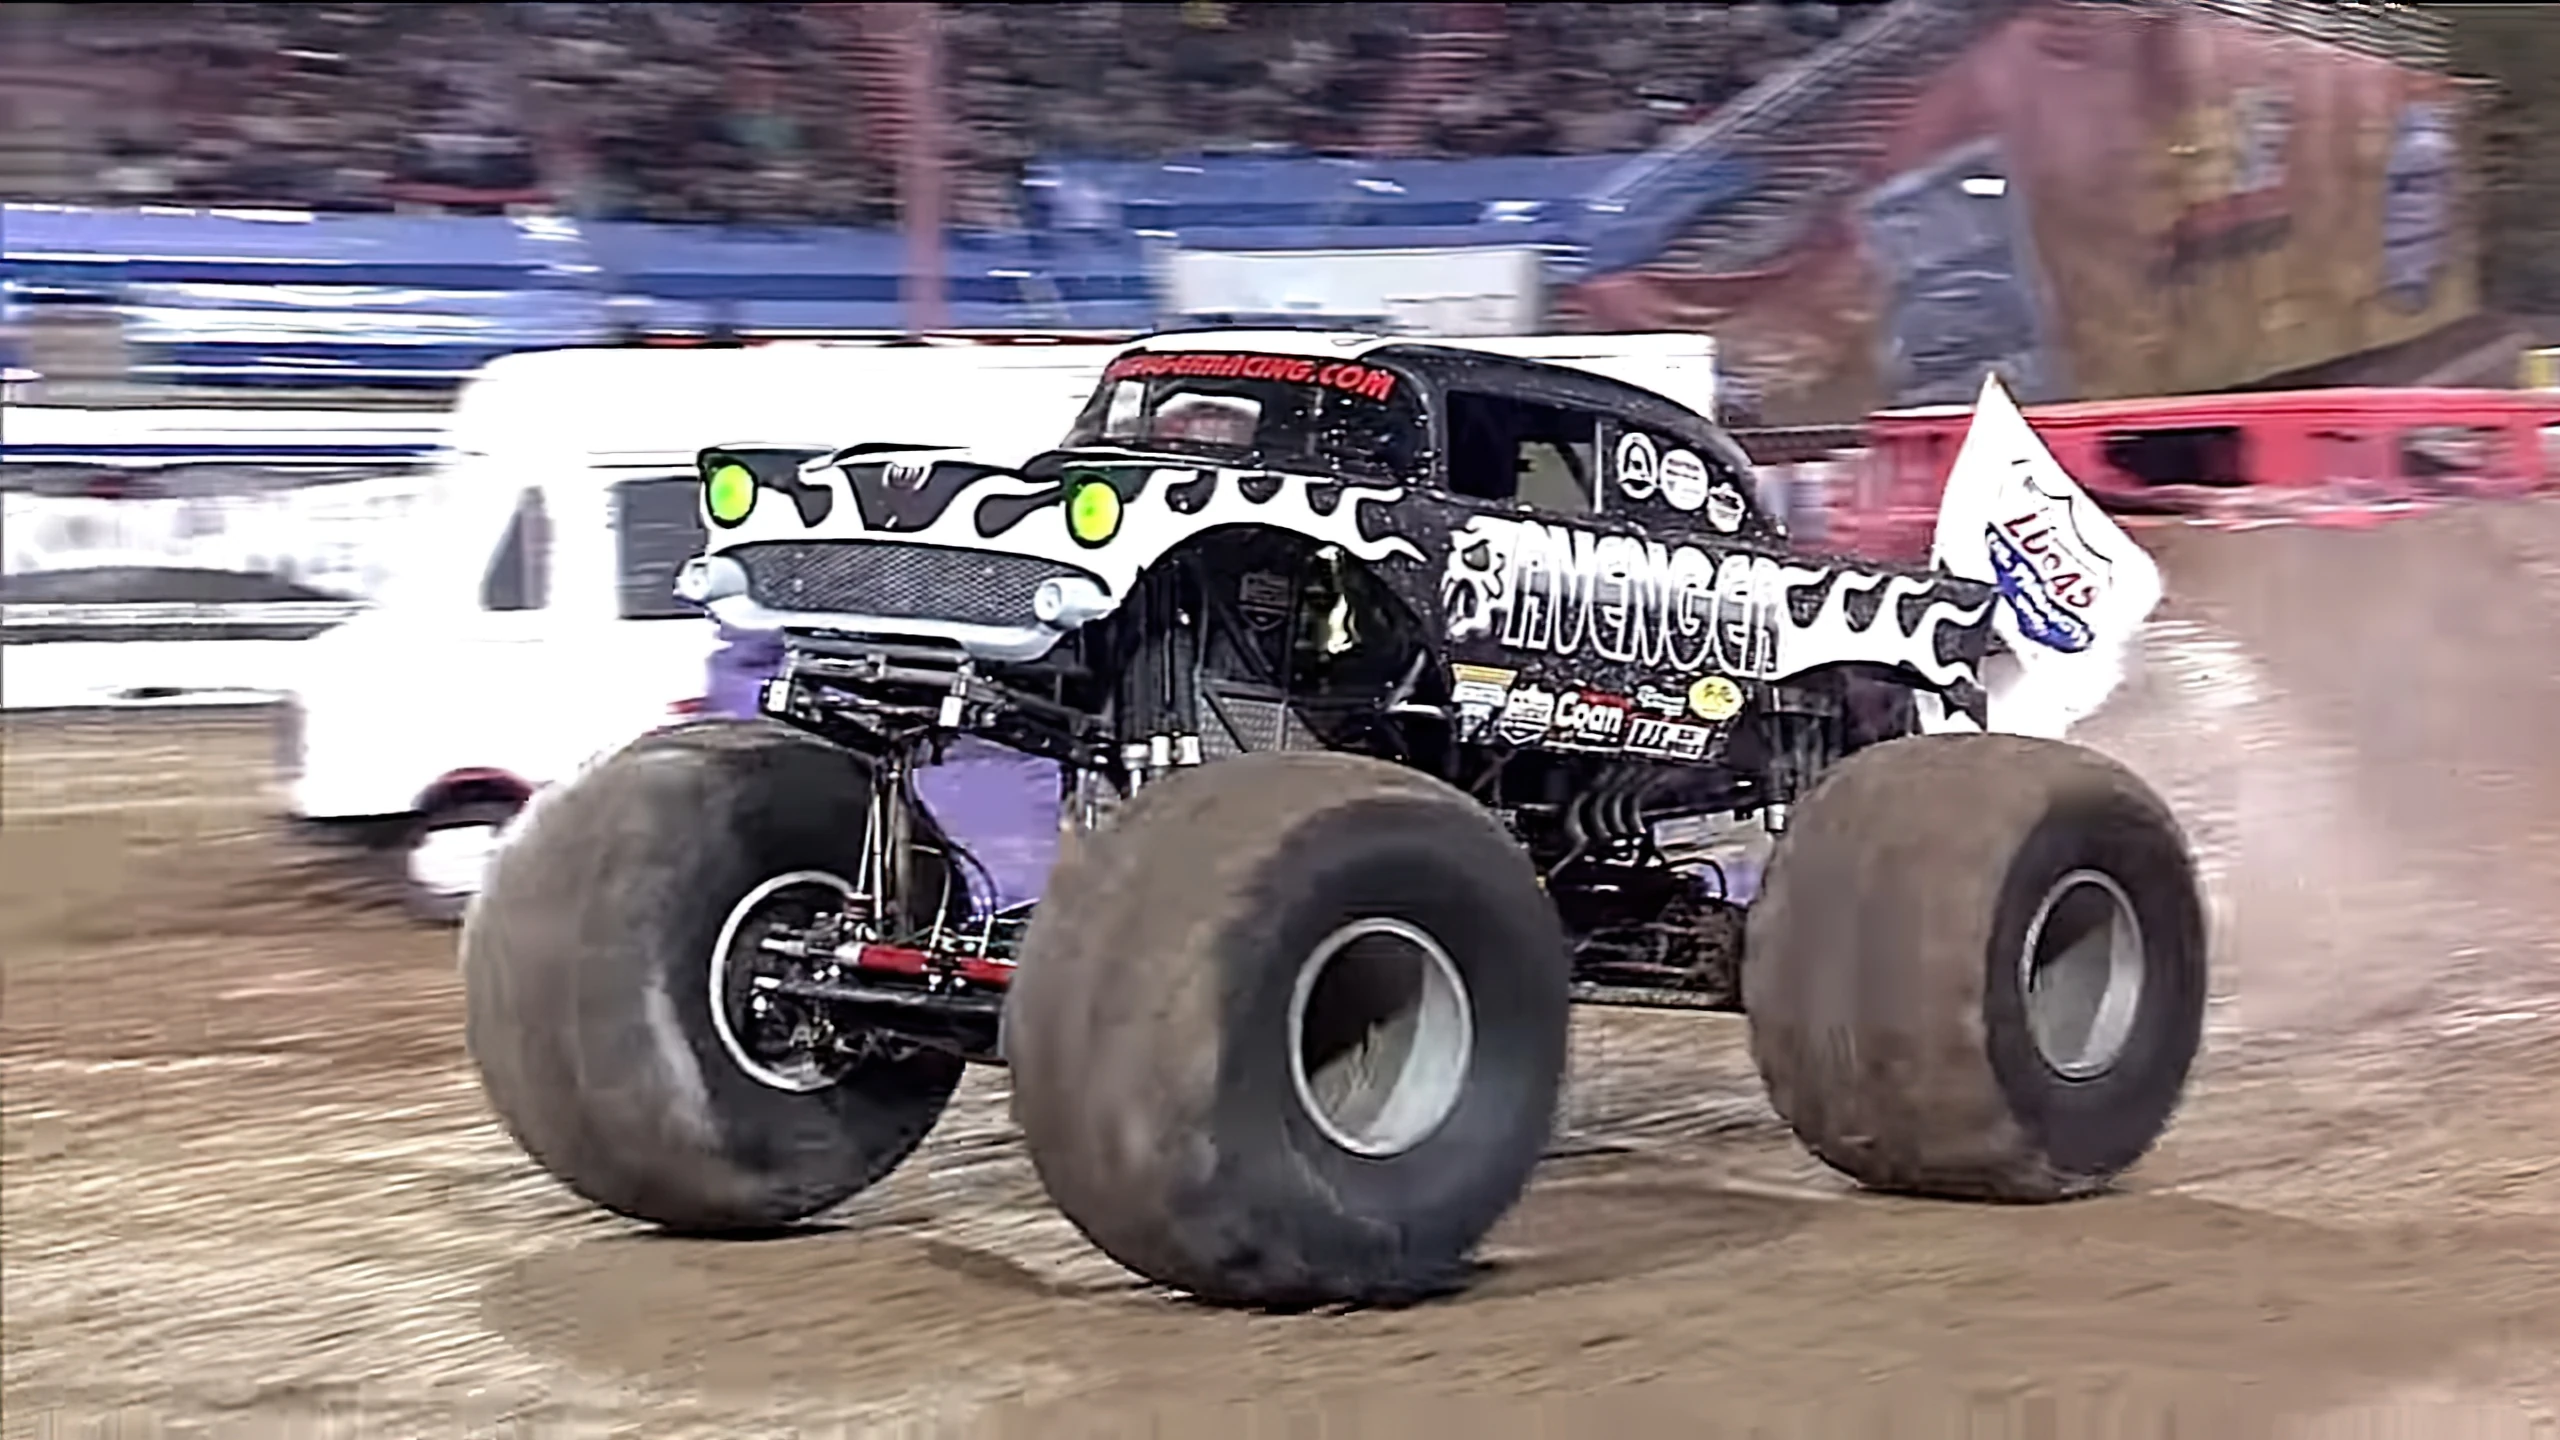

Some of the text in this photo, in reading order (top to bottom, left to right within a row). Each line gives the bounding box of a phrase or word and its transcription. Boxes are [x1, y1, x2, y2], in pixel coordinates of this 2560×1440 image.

[1105, 354, 1396, 401] GERRACING.COM
[1502, 518, 1784, 681] AVENGER
[1555, 690, 1624, 735] Coan
